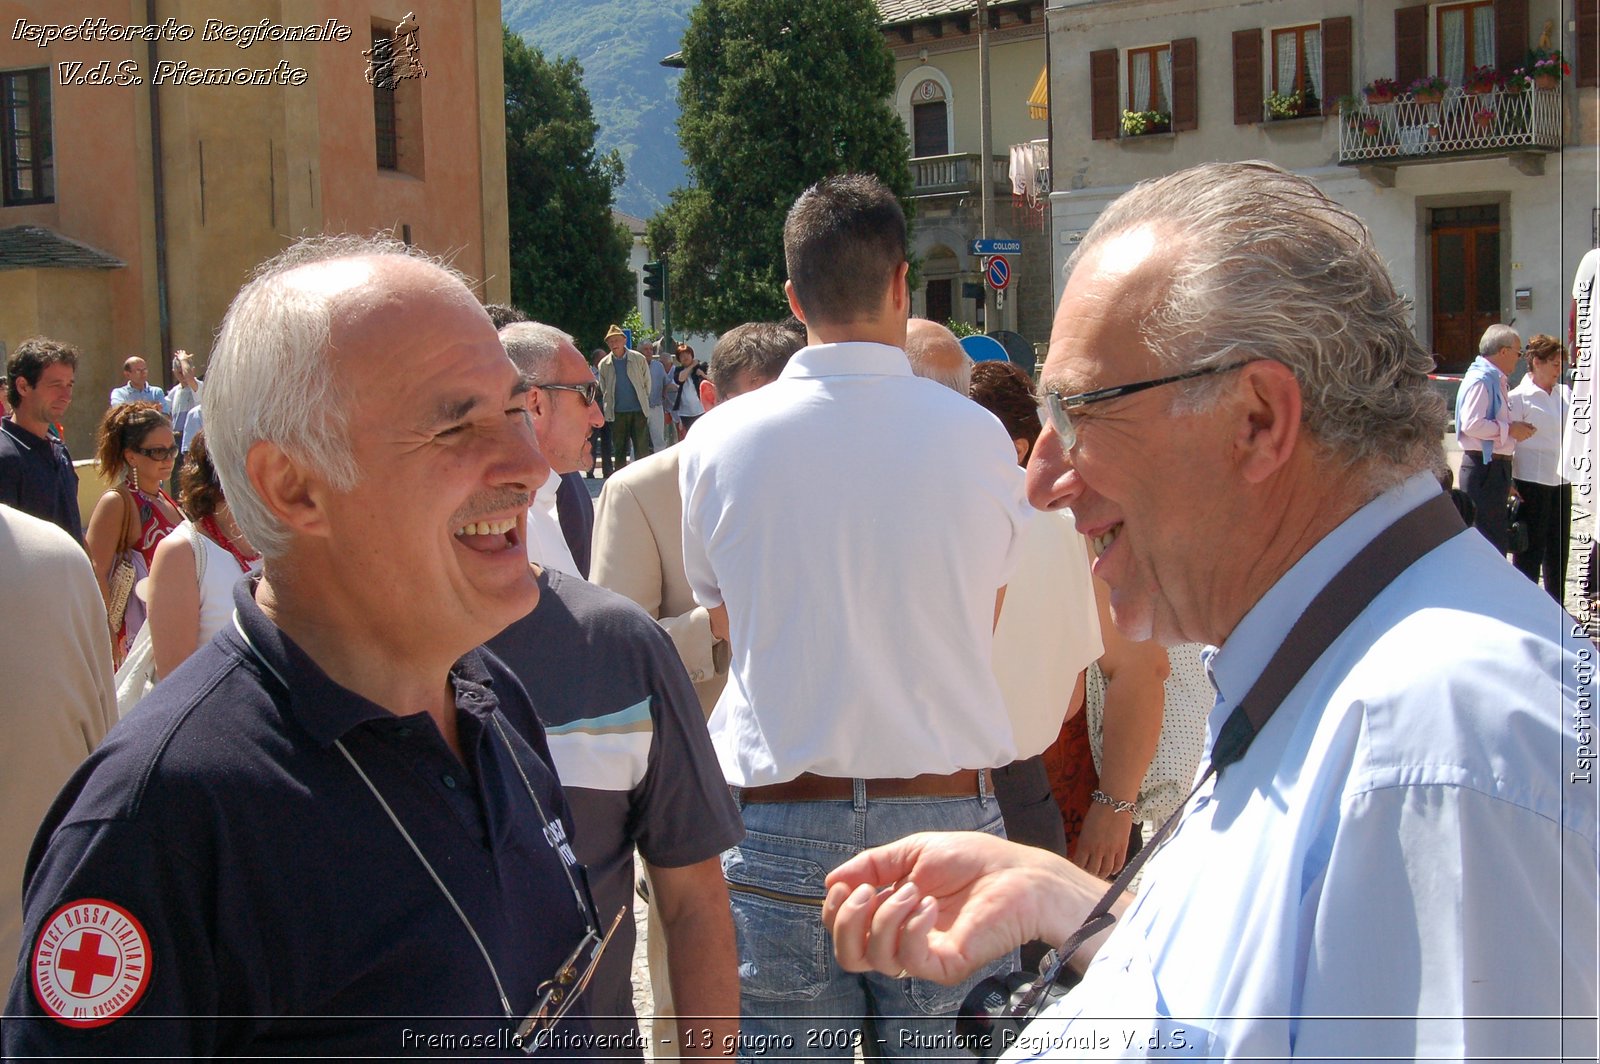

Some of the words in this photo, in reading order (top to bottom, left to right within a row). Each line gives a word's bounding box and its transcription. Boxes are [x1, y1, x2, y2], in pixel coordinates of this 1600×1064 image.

[39, 923, 64, 967] CROCE
[65, 907, 111, 929] ROSSA
[110, 917, 143, 983] ITALIANA
[92, 983, 134, 1017] SOCCORSO
